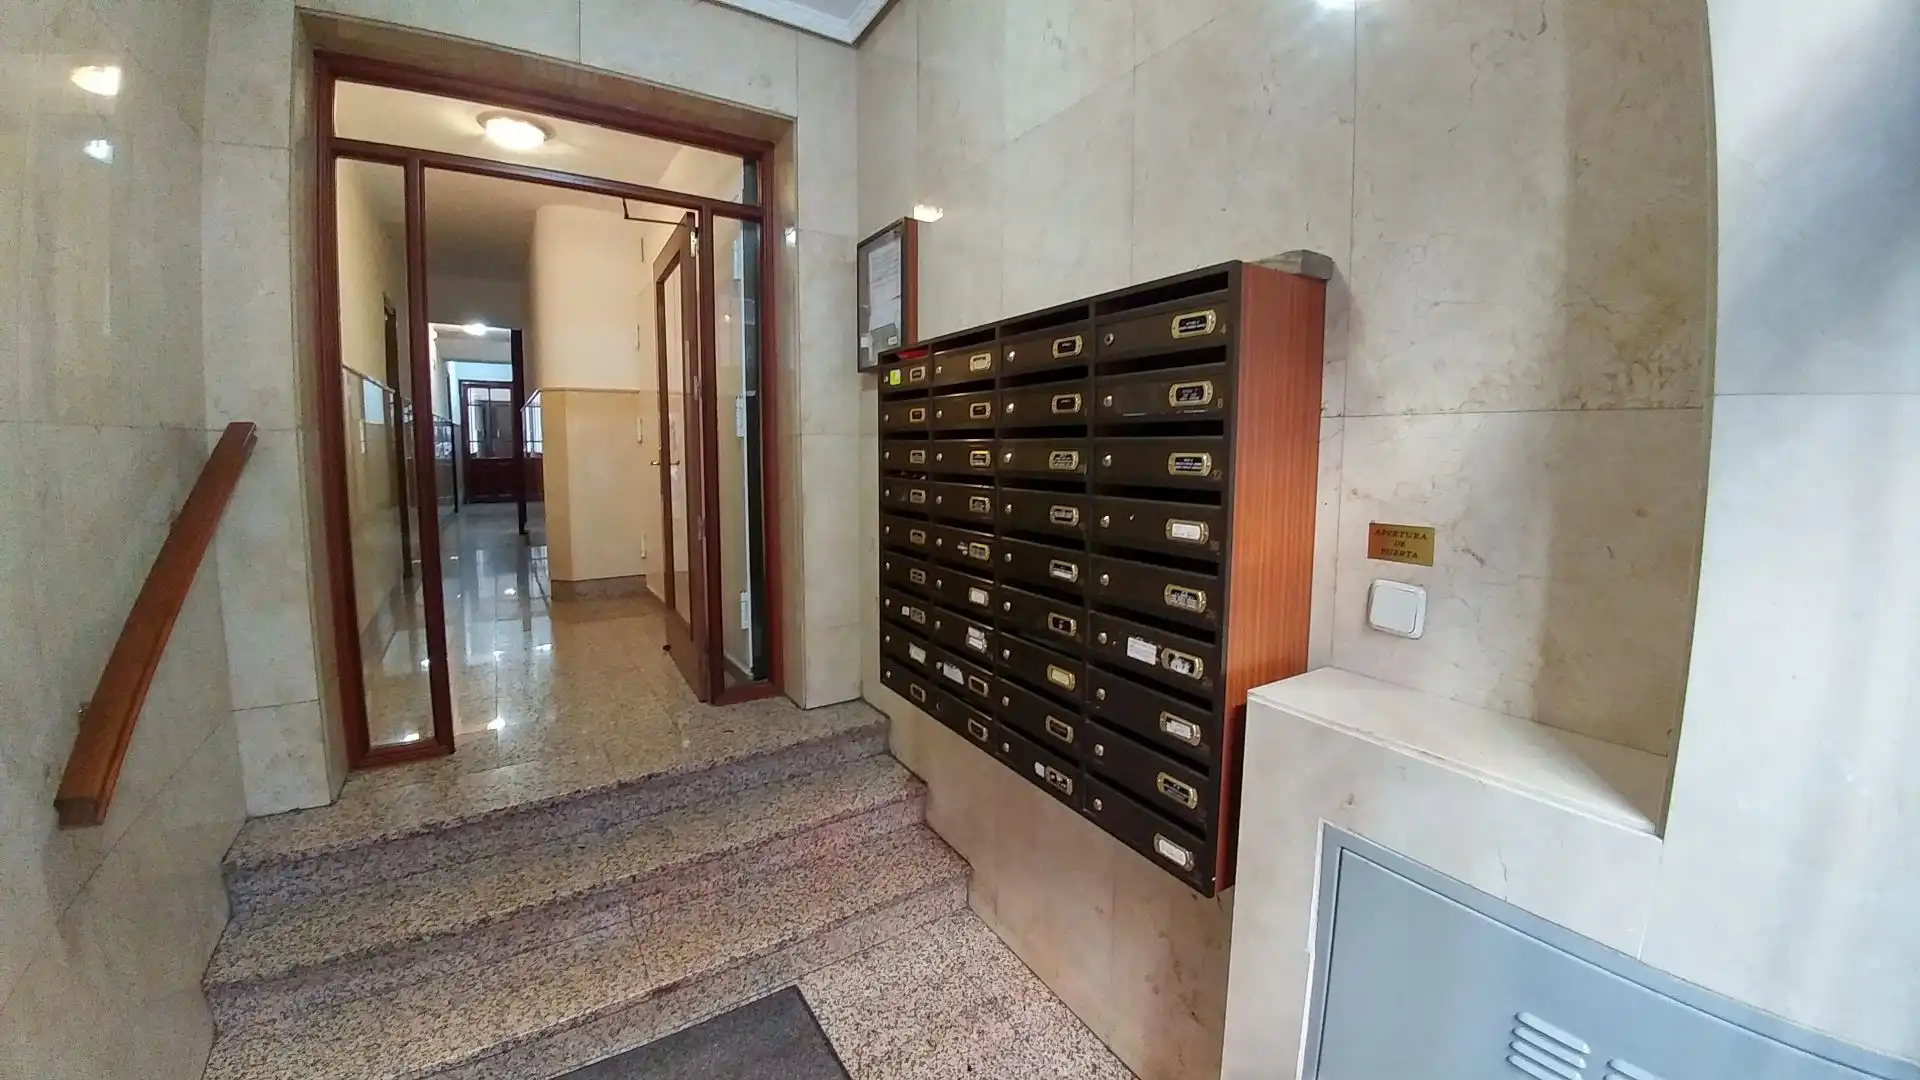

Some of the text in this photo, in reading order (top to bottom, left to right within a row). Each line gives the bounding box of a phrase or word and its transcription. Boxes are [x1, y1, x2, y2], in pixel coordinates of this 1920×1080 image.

[1374, 529, 1427, 540] APERTURA
[1394, 540, 1406, 548] DE
[1381, 548, 1418, 558] PUERTA
